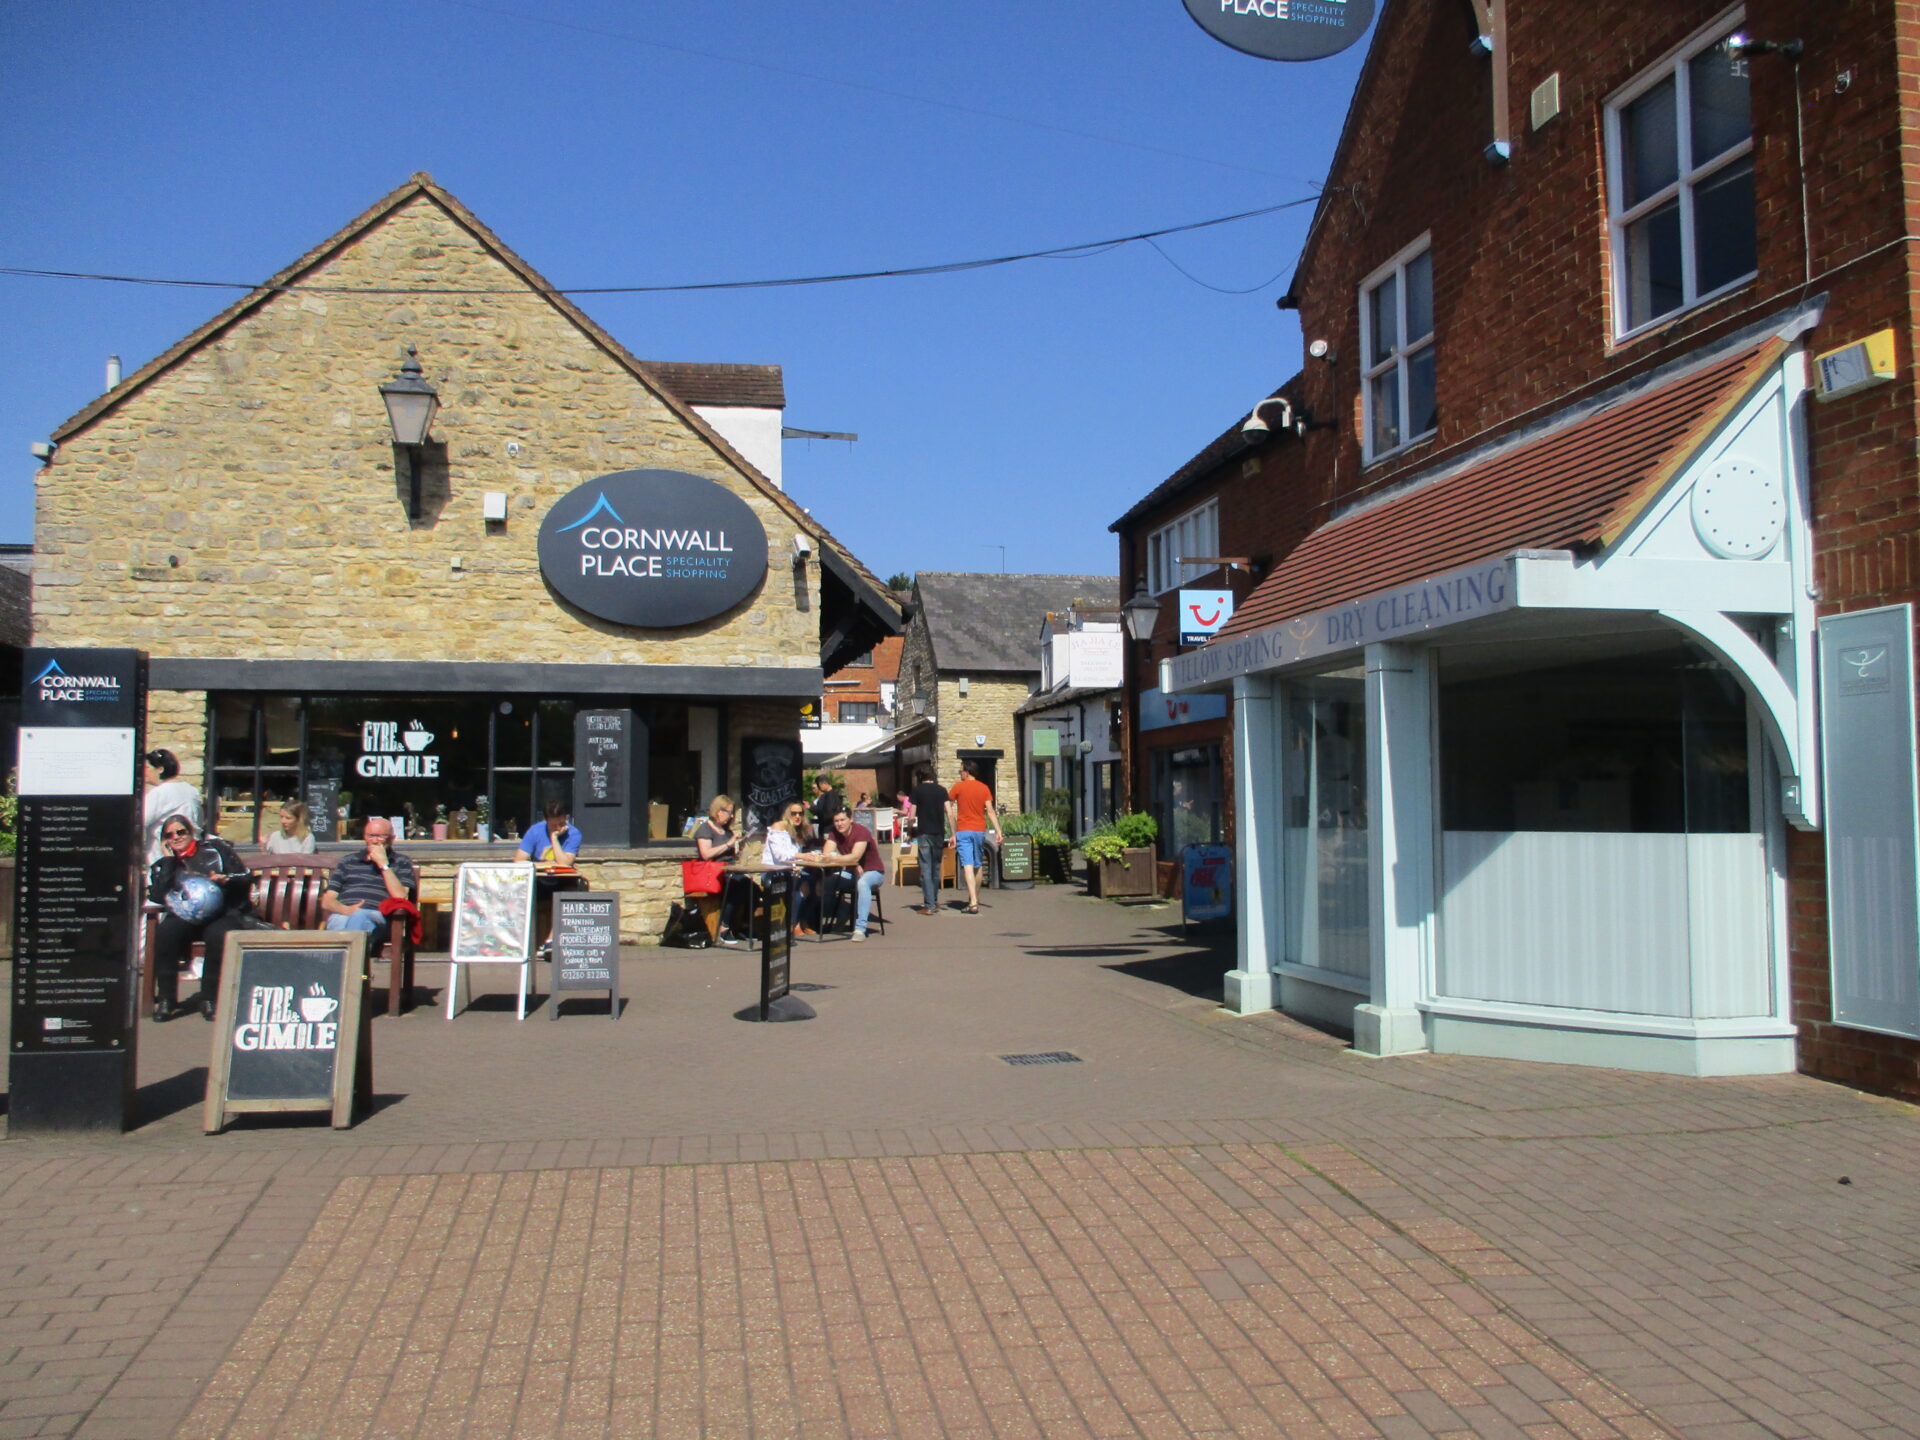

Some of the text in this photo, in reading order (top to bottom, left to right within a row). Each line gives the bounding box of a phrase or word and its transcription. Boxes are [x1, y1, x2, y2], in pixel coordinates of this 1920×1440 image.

[1220, 0, 1289, 20] PLACE
[1291, 2, 1345, 16] SPECIALITY
[1291, 13, 1345, 27] SHOPPING
[581, 527, 733, 552] CORNWALL
[581, 554, 662, 577] PLACE
[666, 556, 731, 567] SPECIALITY
[666, 569, 727, 579] SHOPPING
[1327, 566, 1506, 646] DRY CLEANING
[1227, 631, 1283, 671] SPRING
[41, 676, 120, 688] CORNWALL
[41, 689, 84, 701] PLACE
[362, 721, 405, 752] GYRE &
[356, 755, 440, 777] GIMBLE
[562, 903, 611, 913] HAIR HOST
[561, 918, 594, 926] TRAINING
[572, 925, 610, 934] TUESDAYS!
[562, 934, 610, 944] MODELS NEEDED
[250, 986, 294, 1023] GYRE
[234, 1023, 338, 1051] GIMBLE
